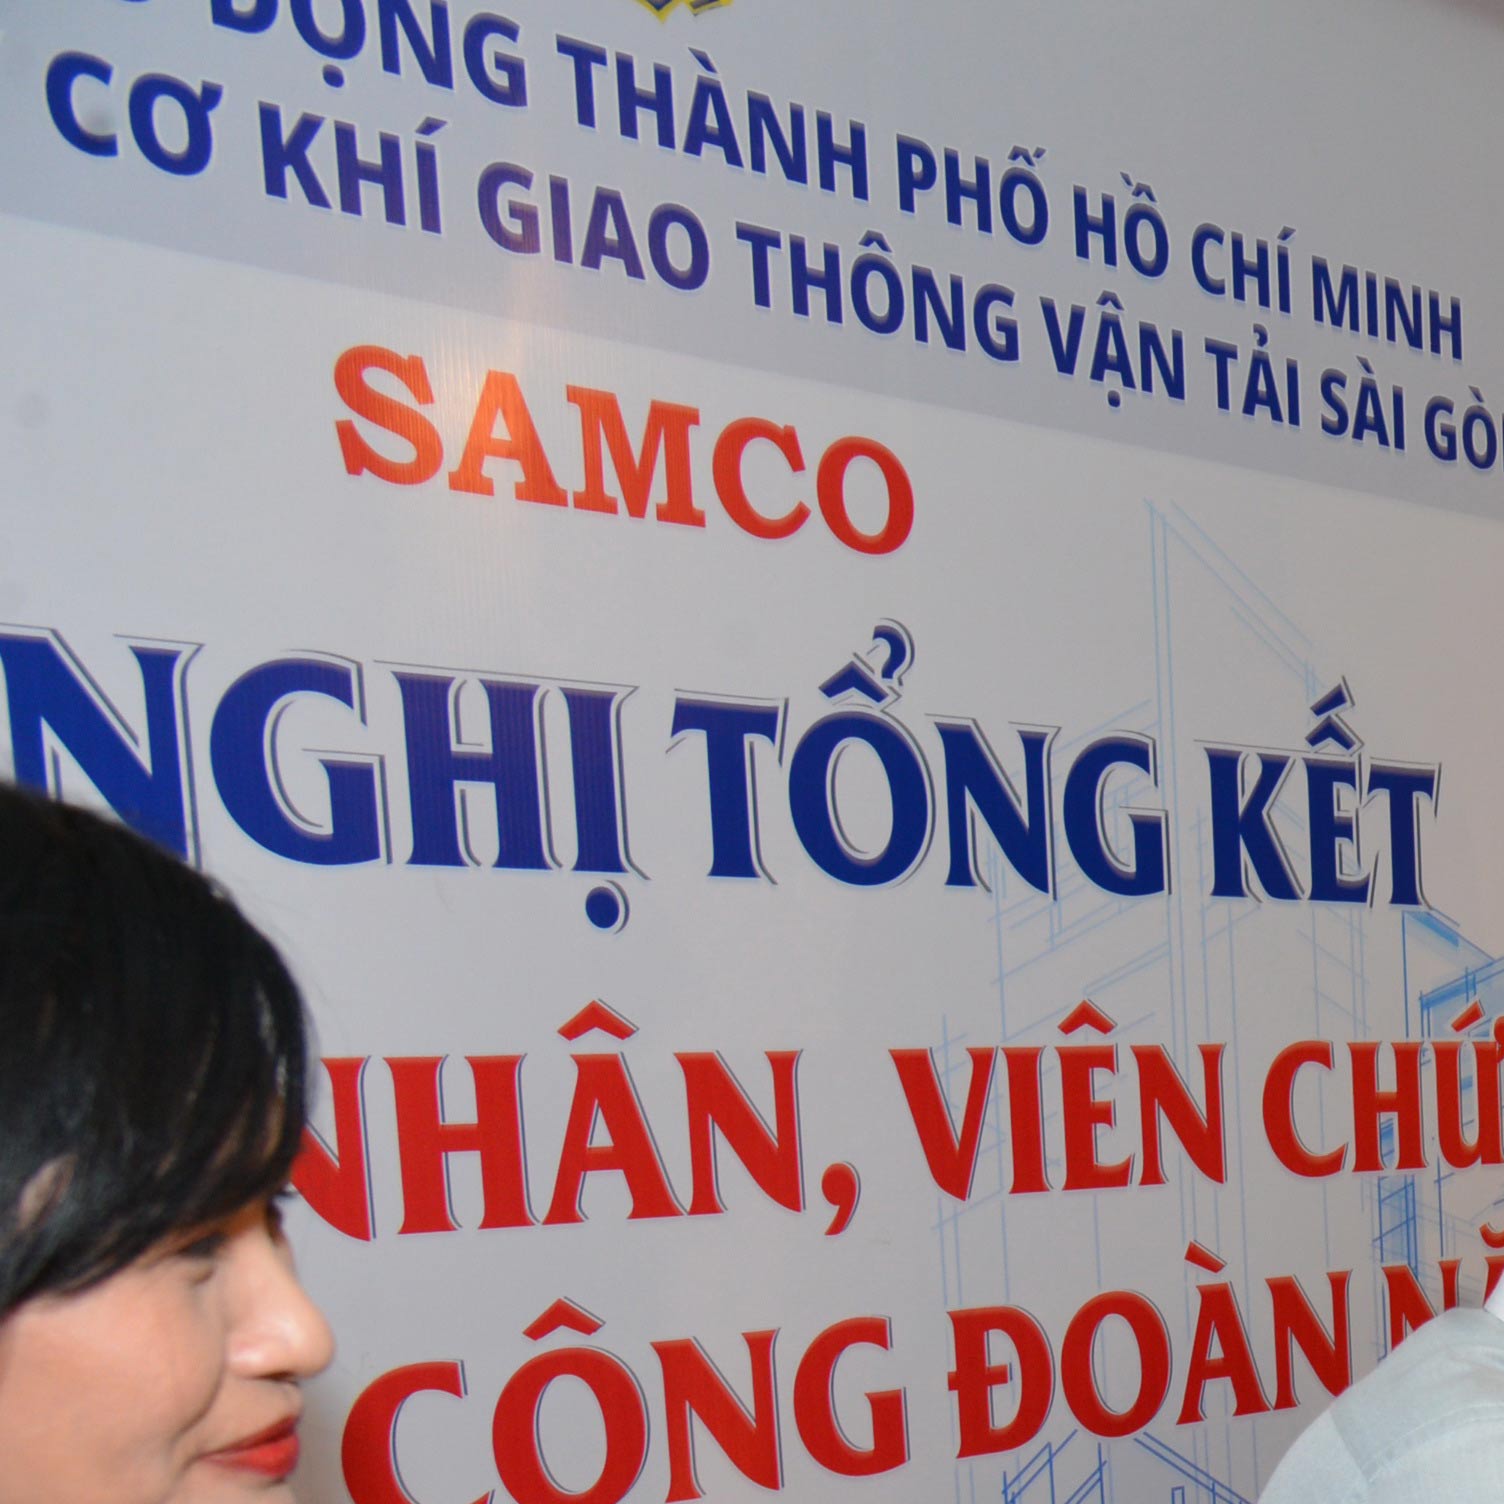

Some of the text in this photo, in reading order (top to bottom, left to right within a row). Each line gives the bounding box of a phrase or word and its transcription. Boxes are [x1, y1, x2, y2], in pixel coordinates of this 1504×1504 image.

[46, 50, 224, 176] CƠ
[258, 100, 449, 235] KHÍ
[477, 162, 710, 291] GIAO
[736, 222, 1020, 363] THÔNG
[1040, 291, 1187, 408] VẬN
[1204, 324, 1300, 427] TẢI
[1320, 357, 1405, 450] SÀI
[556, 33, 869, 200] THÀNH
[897, 134, 1048, 245] PHỐ
[1073, 173, 1169, 278] HỒ
[1191, 222, 1297, 315] CHÍ
[1312, 256, 1463, 360] MINH
[333, 344, 915, 556] SAMCO
[667, 620, 1170, 900] TỔNG
[1195, 676, 1442, 910] KẾT
[888, 999, 1227, 1202] VIÊN
[946, 1240, 1353, 1460] ĐOÀN
